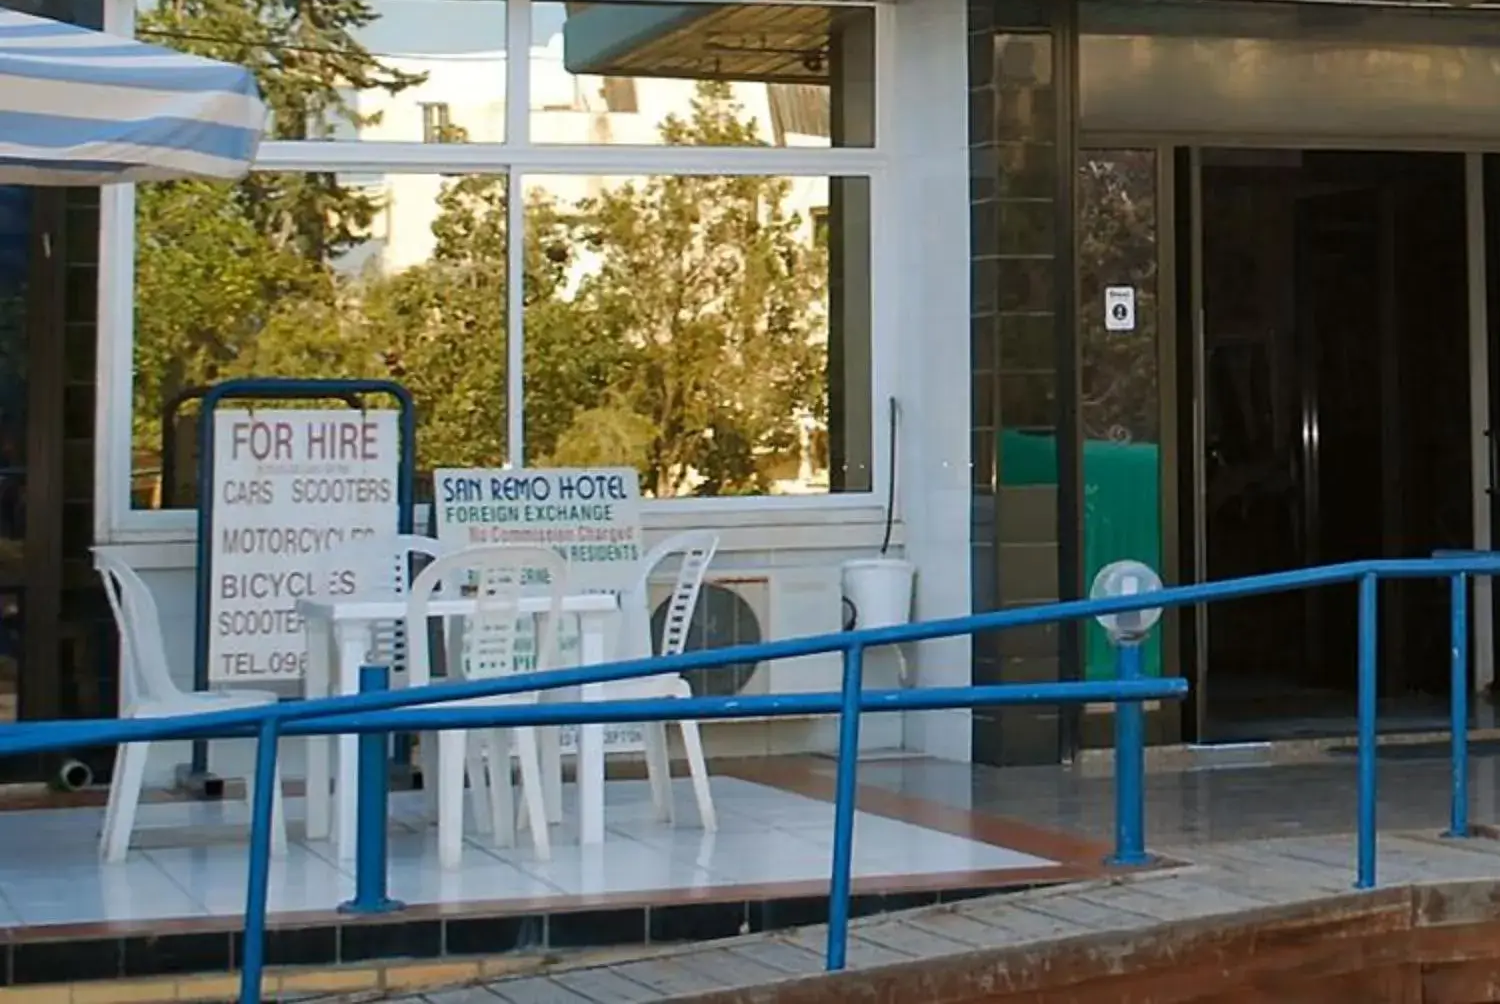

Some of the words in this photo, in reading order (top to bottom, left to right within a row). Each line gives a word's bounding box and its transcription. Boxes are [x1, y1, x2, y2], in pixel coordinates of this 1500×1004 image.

[232, 422, 293, 461] FOR
[307, 422, 379, 461] HIRE
[223, 480, 274, 505] CARS
[291, 478, 392, 504] SCOOTERS
[443, 476, 483, 502] SAN
[490, 475, 551, 501] REMO
[558, 476, 628, 500] HOTEL
[446, 505, 519, 523] FOREIGN
[525, 504, 614, 521] EXCHANGE
[571, 544, 638, 562] RESIDENTS
